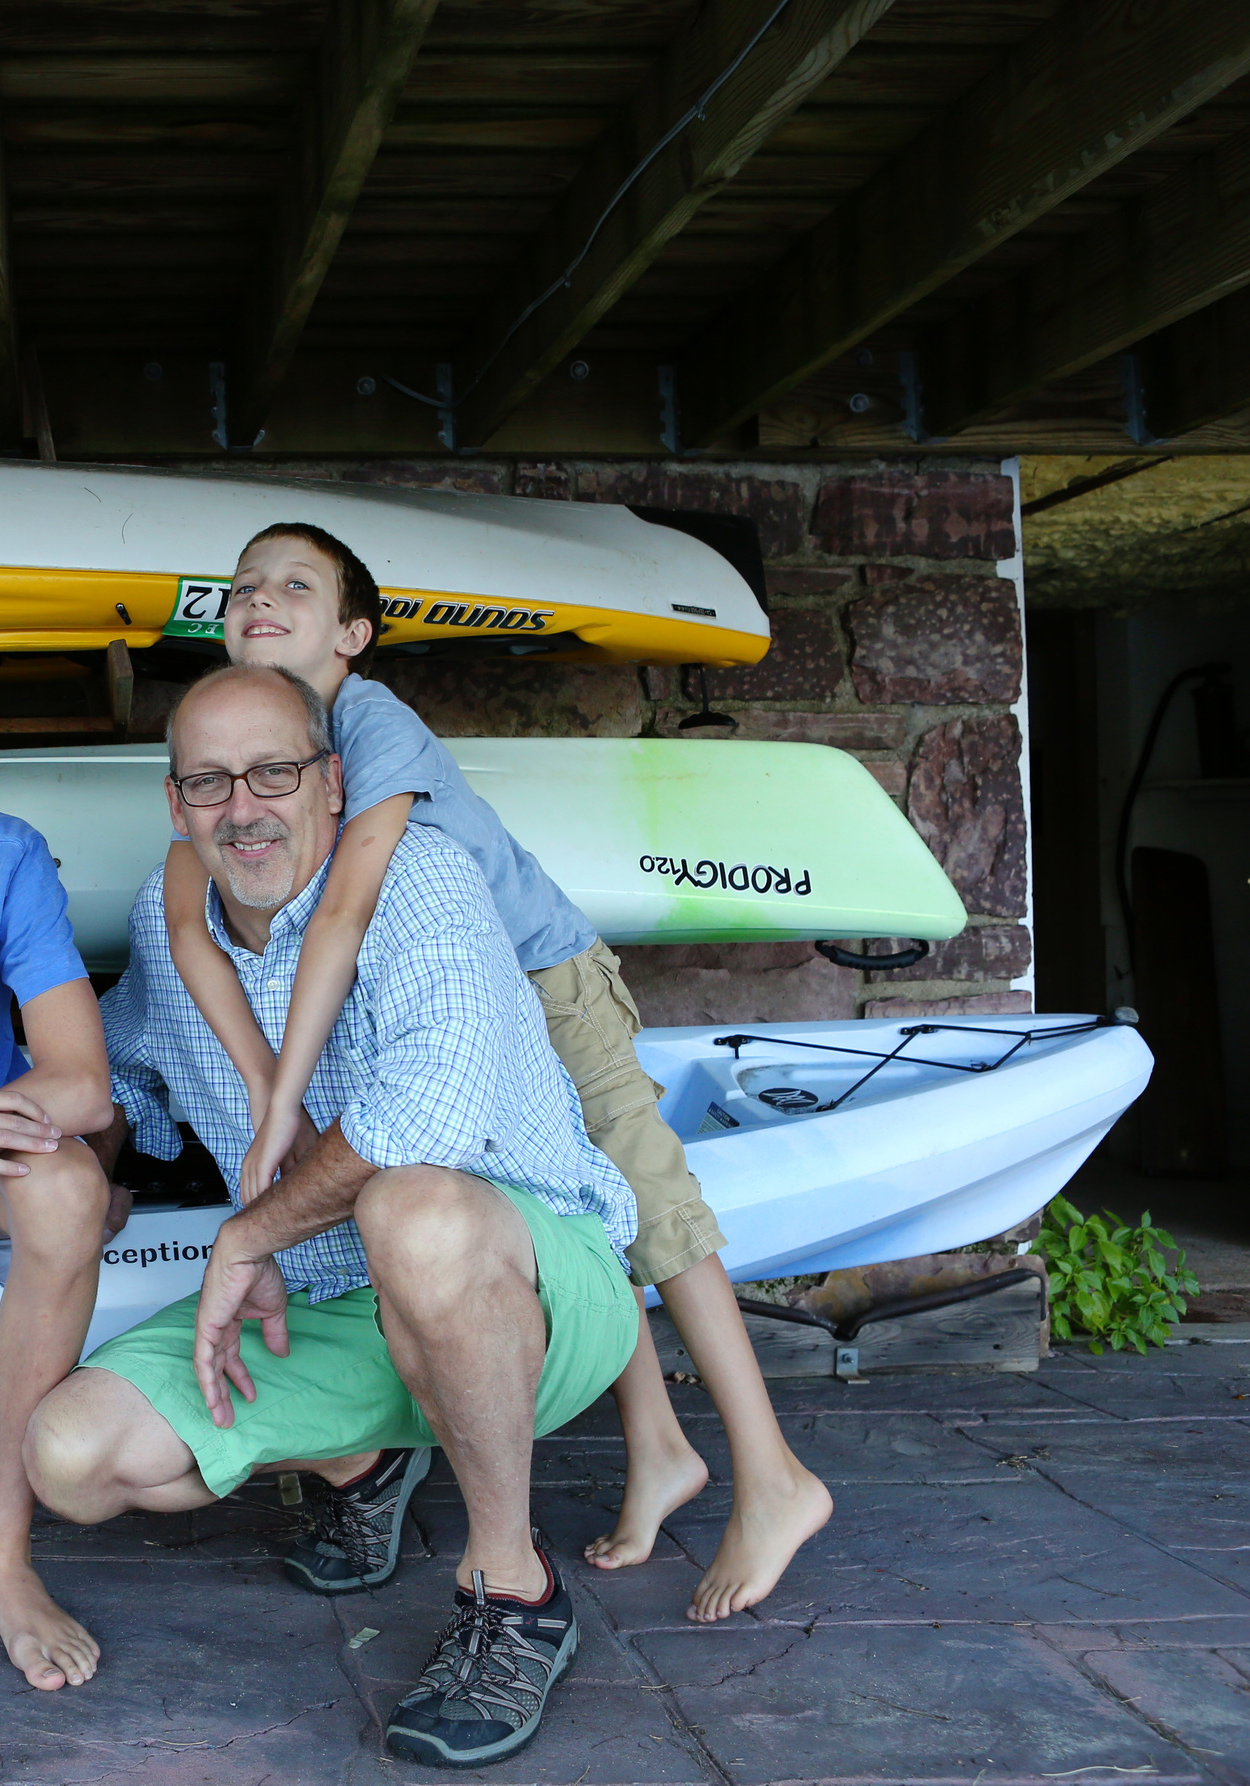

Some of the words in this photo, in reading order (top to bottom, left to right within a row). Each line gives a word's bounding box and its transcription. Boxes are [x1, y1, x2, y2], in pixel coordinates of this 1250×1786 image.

[182, 585, 231, 620] 12
[423, 601, 555, 630] SOUND
[673, 858, 812, 896] PRODIGY
